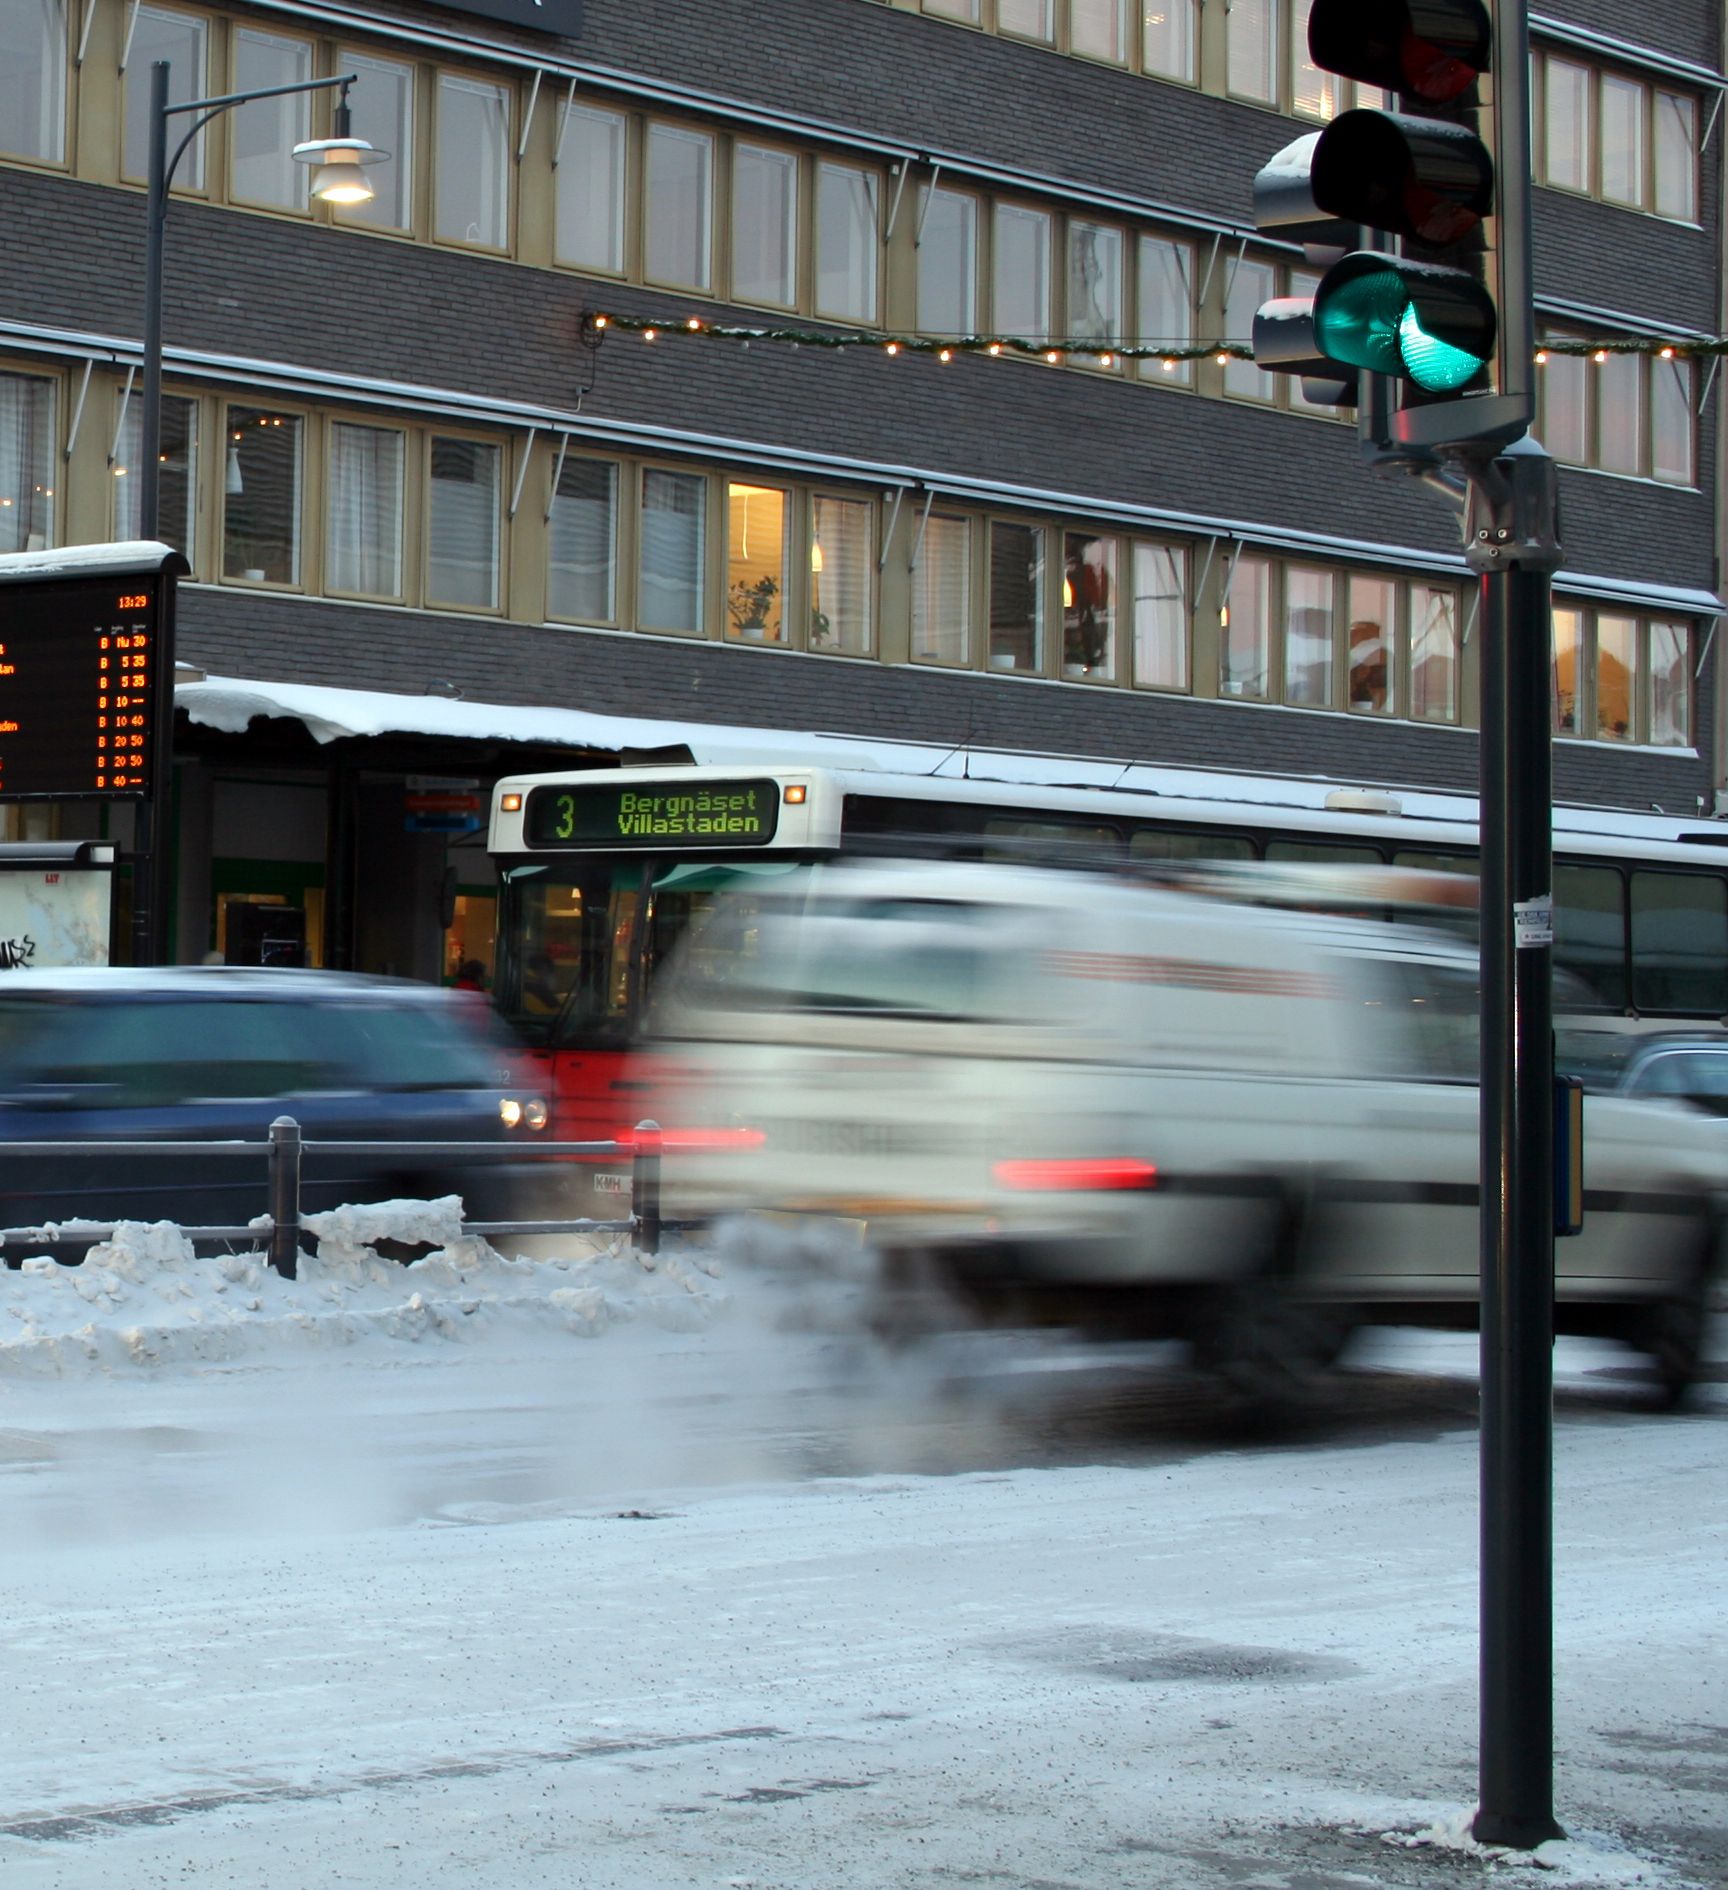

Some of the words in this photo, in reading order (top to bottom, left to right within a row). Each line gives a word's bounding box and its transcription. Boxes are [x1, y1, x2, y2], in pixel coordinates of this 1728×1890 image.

[120, 596, 147, 609] 13:29
[100, 638, 109, 649] B
[117, 636, 130, 648] Nu
[133, 635, 146, 647] 30
[100, 658, 108, 669] B
[122, 656, 129, 667] 5
[132, 655, 145, 667] 35
[100, 677, 108, 688] B
[121, 676, 128, 687] 5
[132, 675, 145, 687] 35
[99, 697, 107, 708] B
[116, 696, 128, 707] 10
[99, 717, 106, 728] B
[116, 716, 127, 727] 10
[131, 715, 144, 726] 40
[98, 736, 106, 747] B
[115, 736, 127, 747] 20
[131, 735, 143, 746] 50
[98, 756, 105, 767] B
[114, 756, 126, 767] 20
[130, 755, 142, 766] 50
[97, 776, 105, 787] B
[113, 776, 126, 787] 40
[556, 795, 575, 838] 3
[621, 790, 756, 816] Bergnäset
[618, 811, 759, 834] Villastaden
[596, 1176, 622, 1192] KMH
